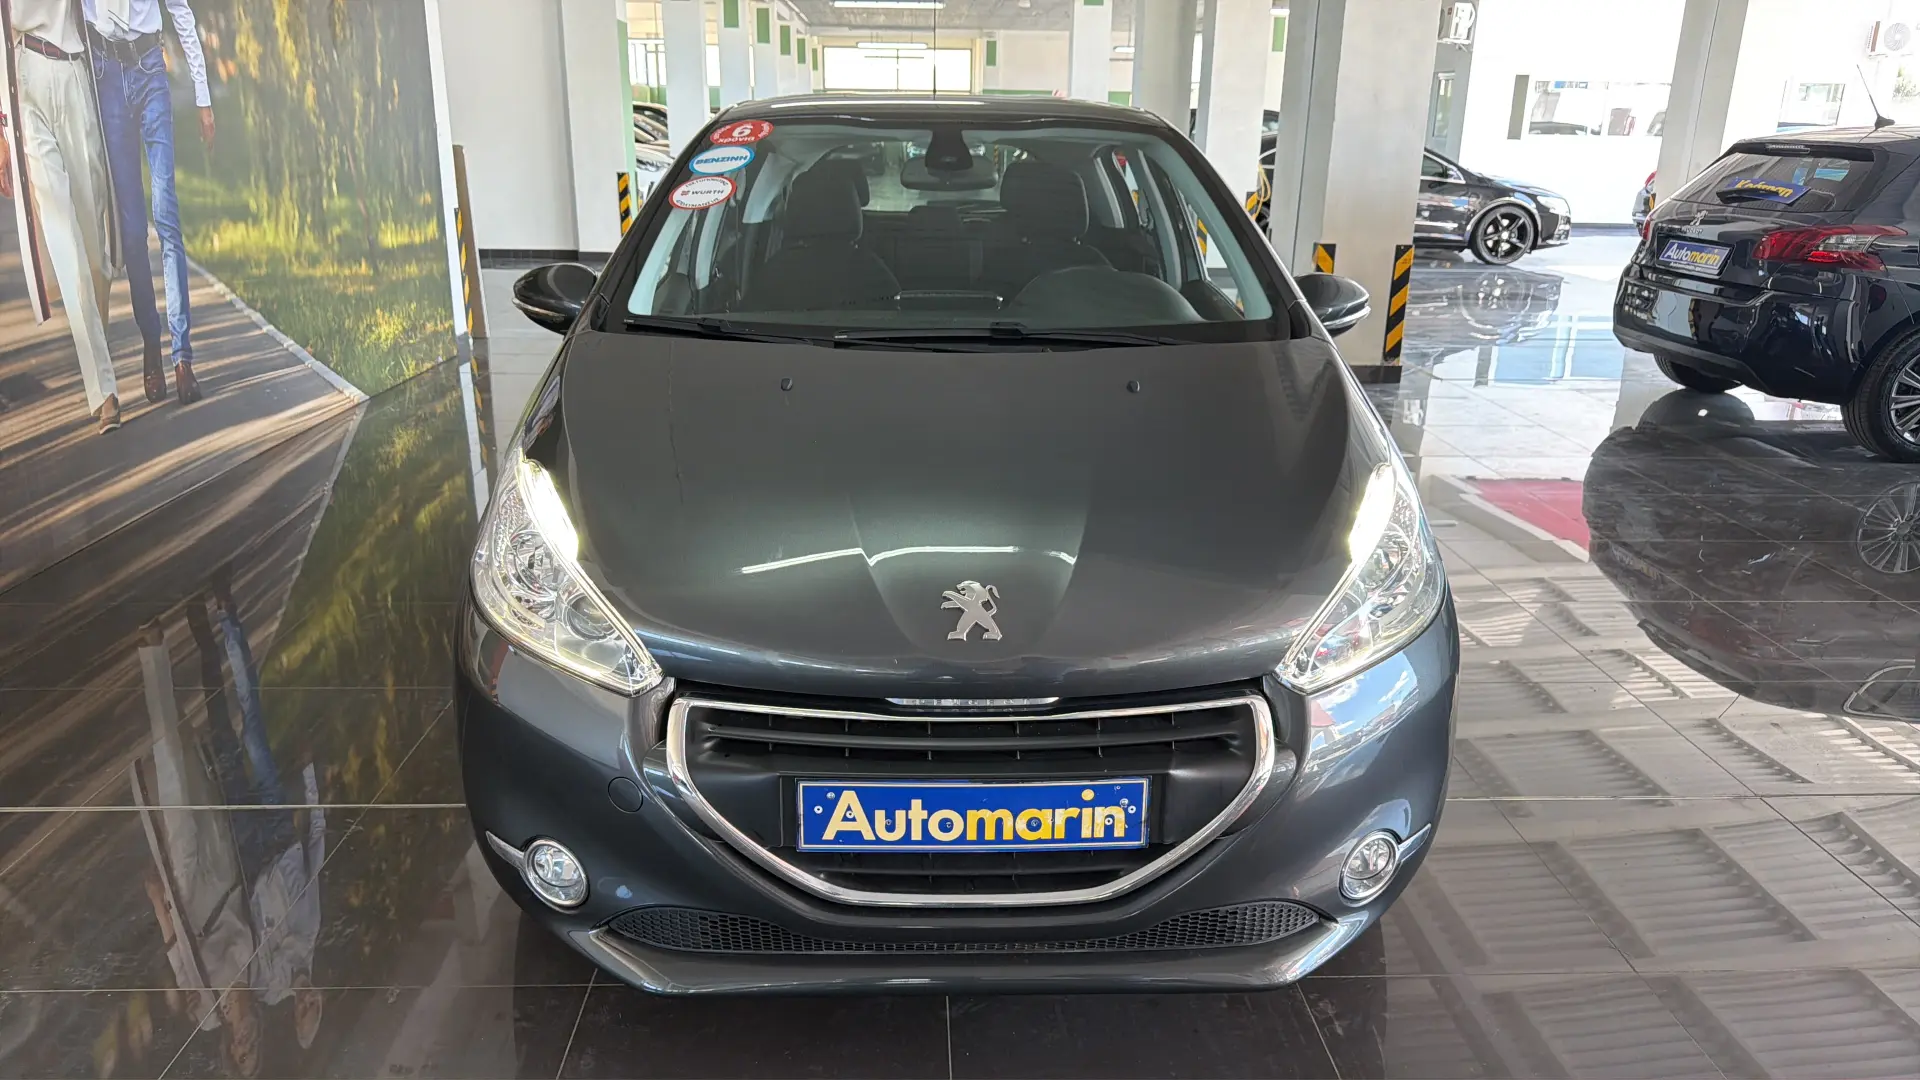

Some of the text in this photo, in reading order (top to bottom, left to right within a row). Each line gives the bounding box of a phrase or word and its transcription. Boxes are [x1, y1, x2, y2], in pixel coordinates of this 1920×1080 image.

[732, 125, 753, 137] 6
[1664, 243, 1720, 265] Automarin
[821, 788, 1126, 841] Automarin
